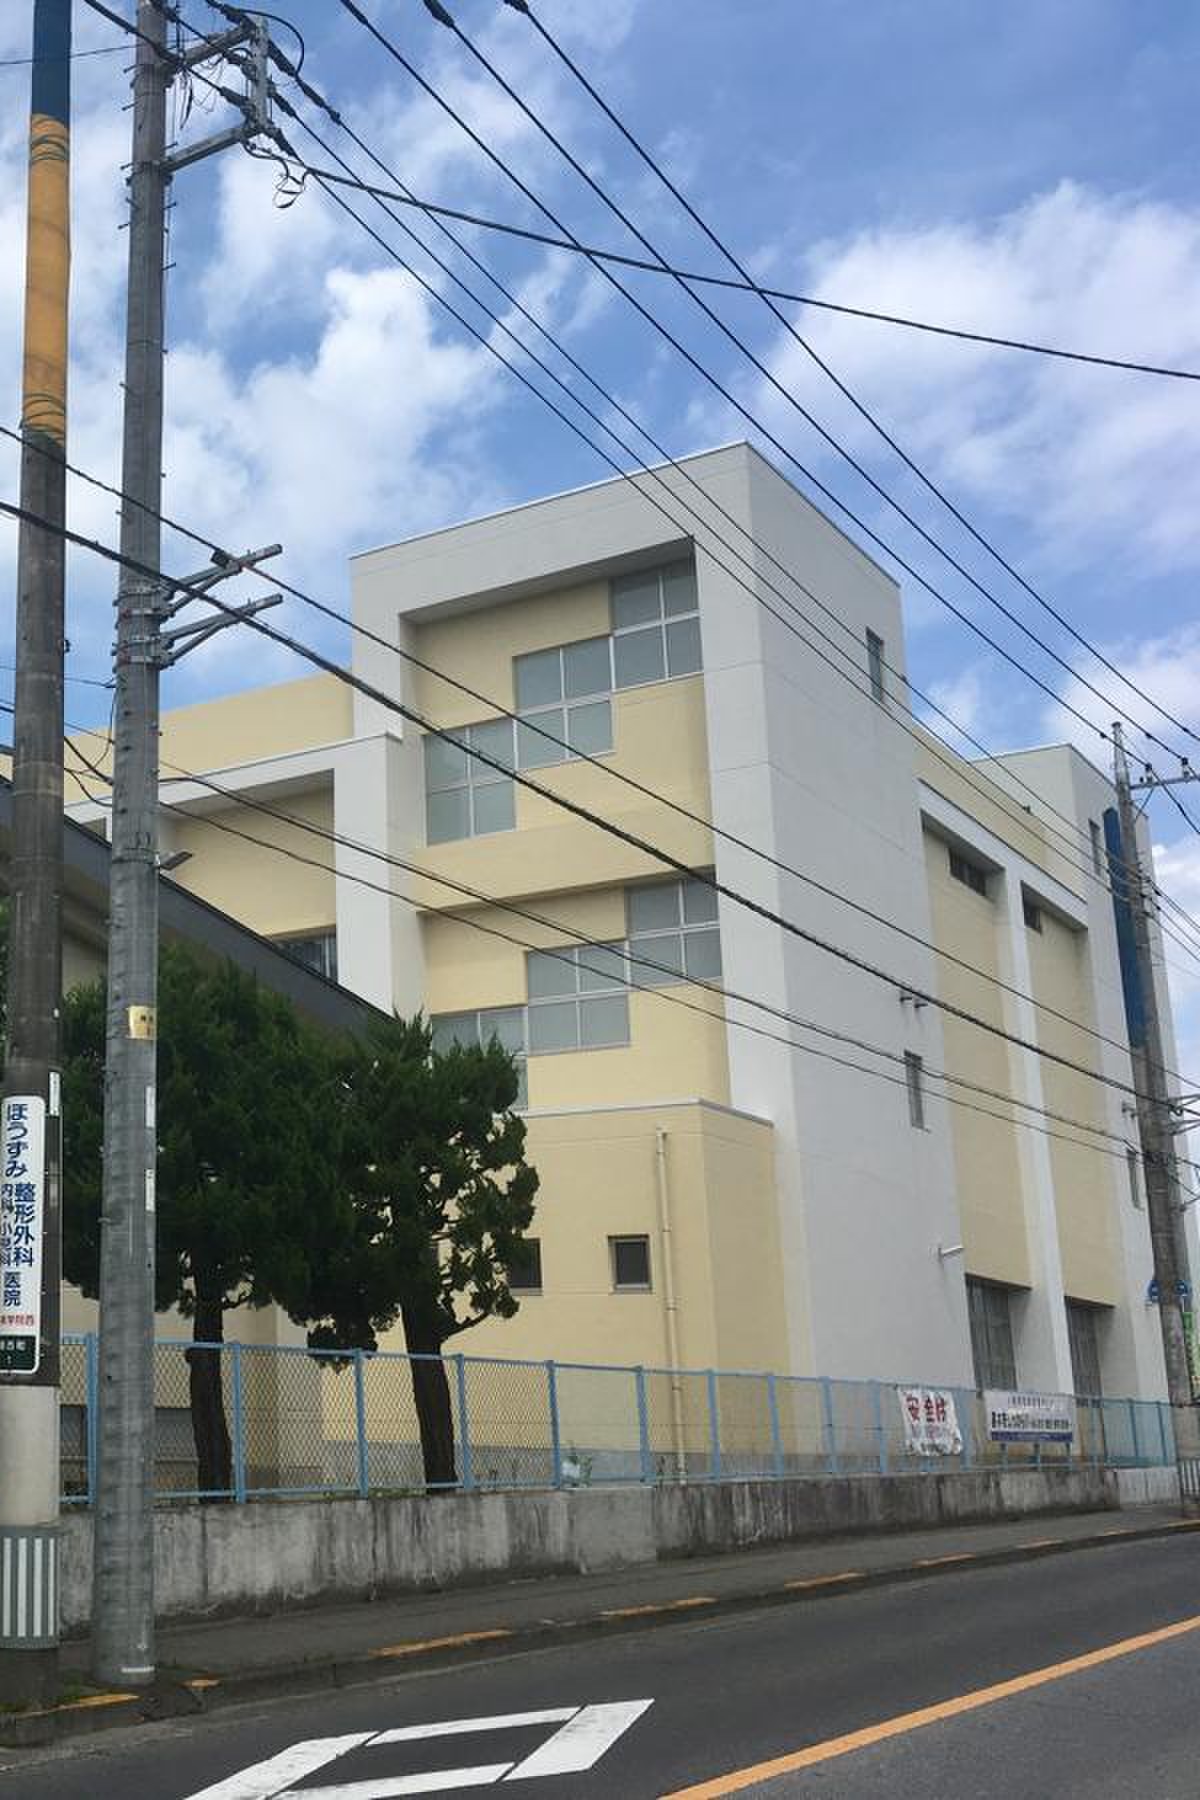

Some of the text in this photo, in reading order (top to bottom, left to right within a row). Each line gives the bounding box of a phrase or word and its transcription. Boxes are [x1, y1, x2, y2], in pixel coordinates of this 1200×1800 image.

[13, 1182, 36, 1268] 整形外科
[3, 1271, 22, 1307] 医院
